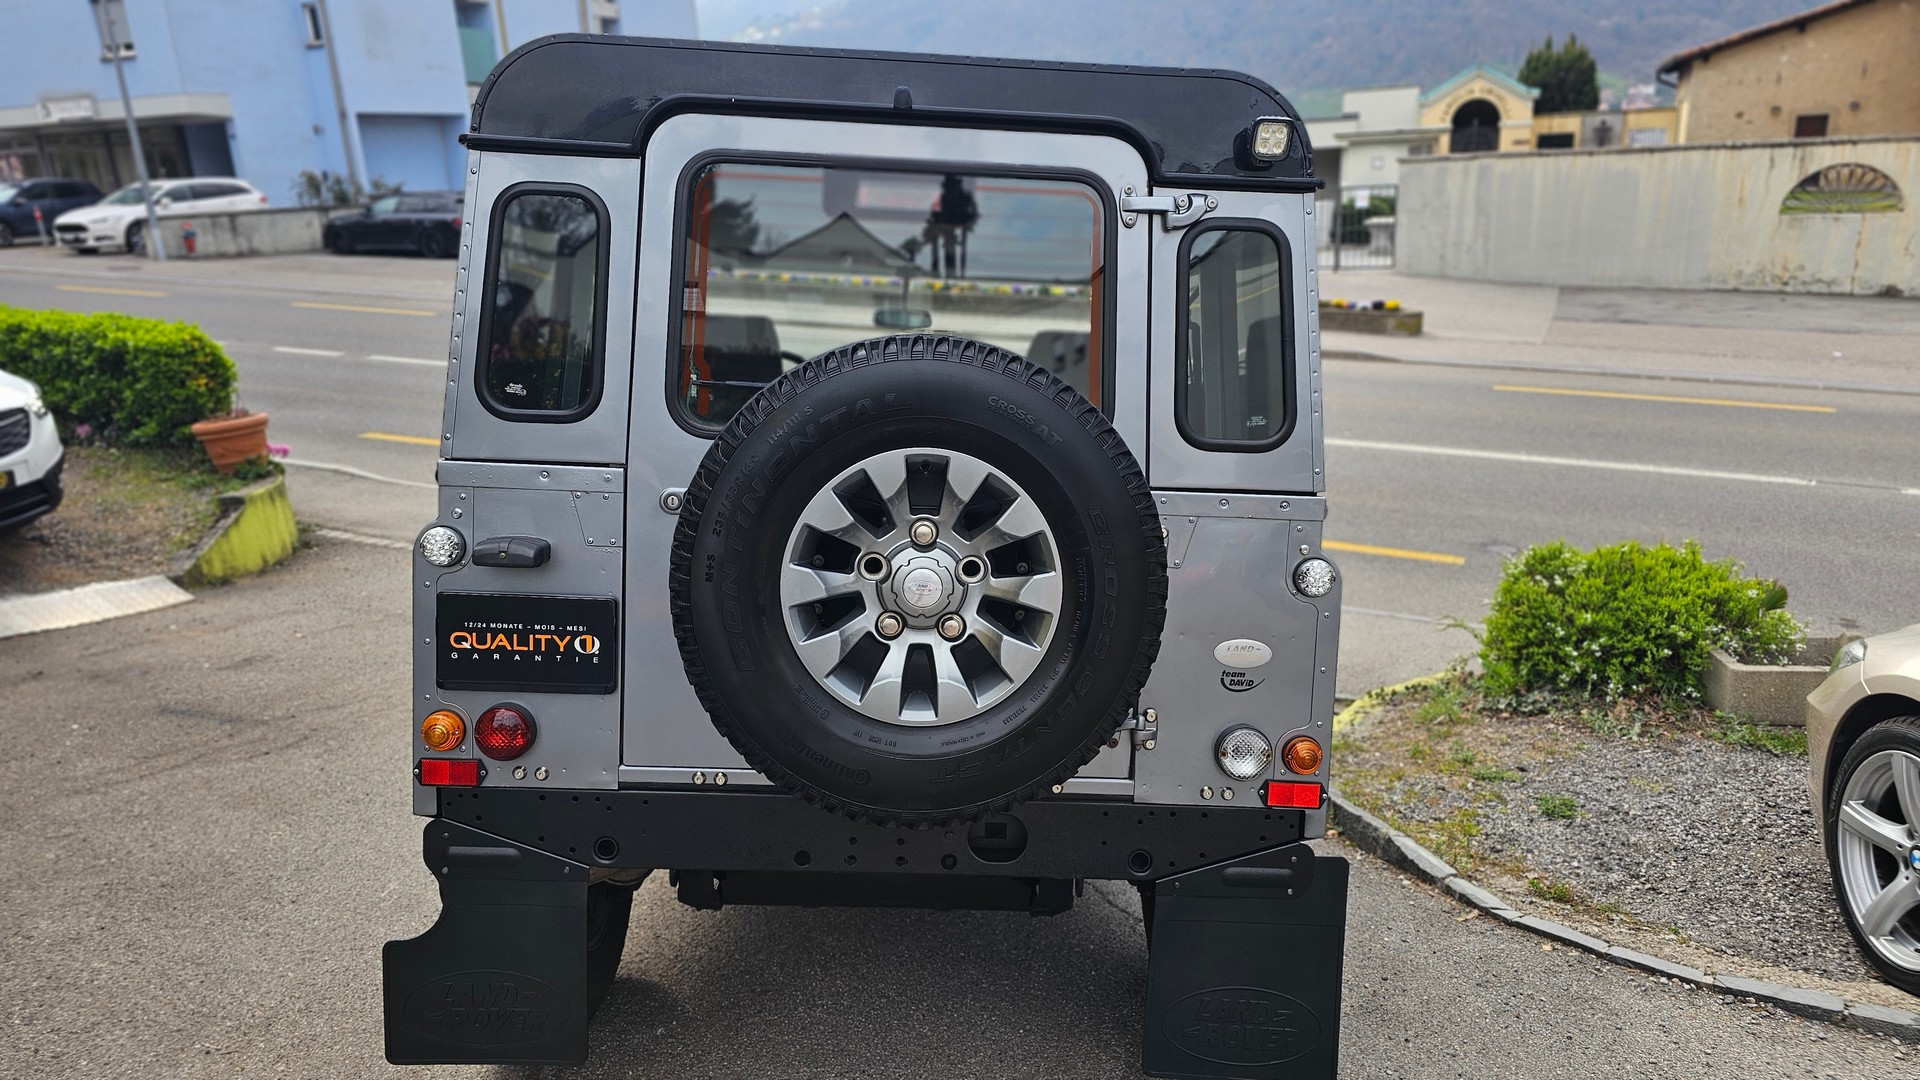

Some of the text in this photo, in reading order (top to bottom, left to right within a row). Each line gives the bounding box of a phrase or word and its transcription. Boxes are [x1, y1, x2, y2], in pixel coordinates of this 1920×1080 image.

[987, 396, 1064, 448] CROSS AT
[721, 391, 912, 674] CONTINENTAL
[705, 553, 716, 582] M+S
[1088, 506, 1117, 659] CROSS
[450, 631, 571, 652] QUALITY
[1222, 670, 1246, 678] team
[439, 982, 518, 1006] LAND
[446, 1008, 549, 1030] ROVER
[1193, 998, 1273, 1024] LAND
[1200, 1024, 1298, 1052] ROVER
